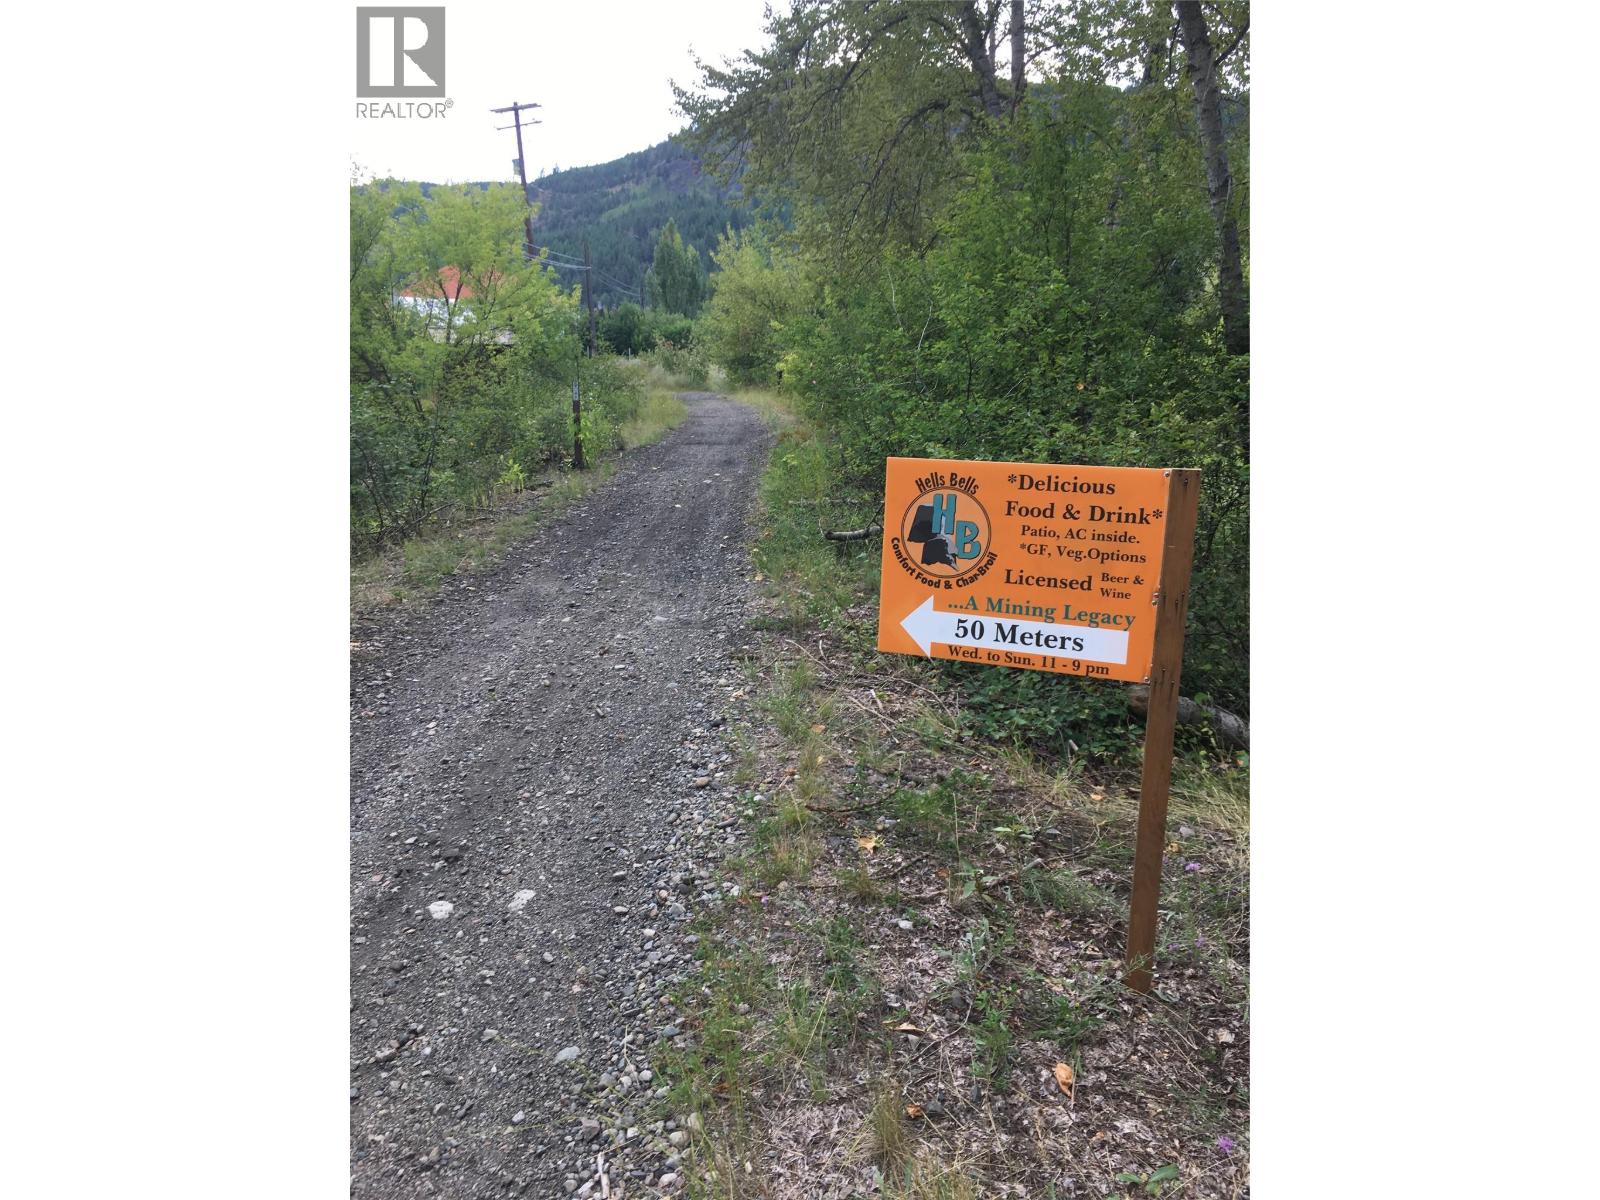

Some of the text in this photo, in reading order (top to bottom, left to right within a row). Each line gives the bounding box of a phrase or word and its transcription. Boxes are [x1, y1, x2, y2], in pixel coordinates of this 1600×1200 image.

[915, 472, 979, 495] Hells Bells
[1004, 500, 1055, 518] Food
[1062, 504, 1080, 520] &
[1021, 524, 1140, 544] Patio, AC inside.
[891, 536, 916, 577] Comfort
[914, 572, 940, 589] Food
[944, 580, 952, 590] &
[1004, 568, 1092, 591] Licensed
[1100, 572, 1144, 585] Beer &
[1100, 588, 1132, 600] Wine
[986, 596, 1056, 623] Mining
[1062, 604, 1136, 631] Legacy
[955, 618, 1084, 652] 50 Meters
[948, 645, 982, 660] Wed.
[988, 650, 1000, 662] to
[1004, 652, 1035, 667] Sun.
[1041, 656, 1056, 668] 11
[1072, 660, 1080, 672] 9
[1085, 664, 1110, 676] pm
